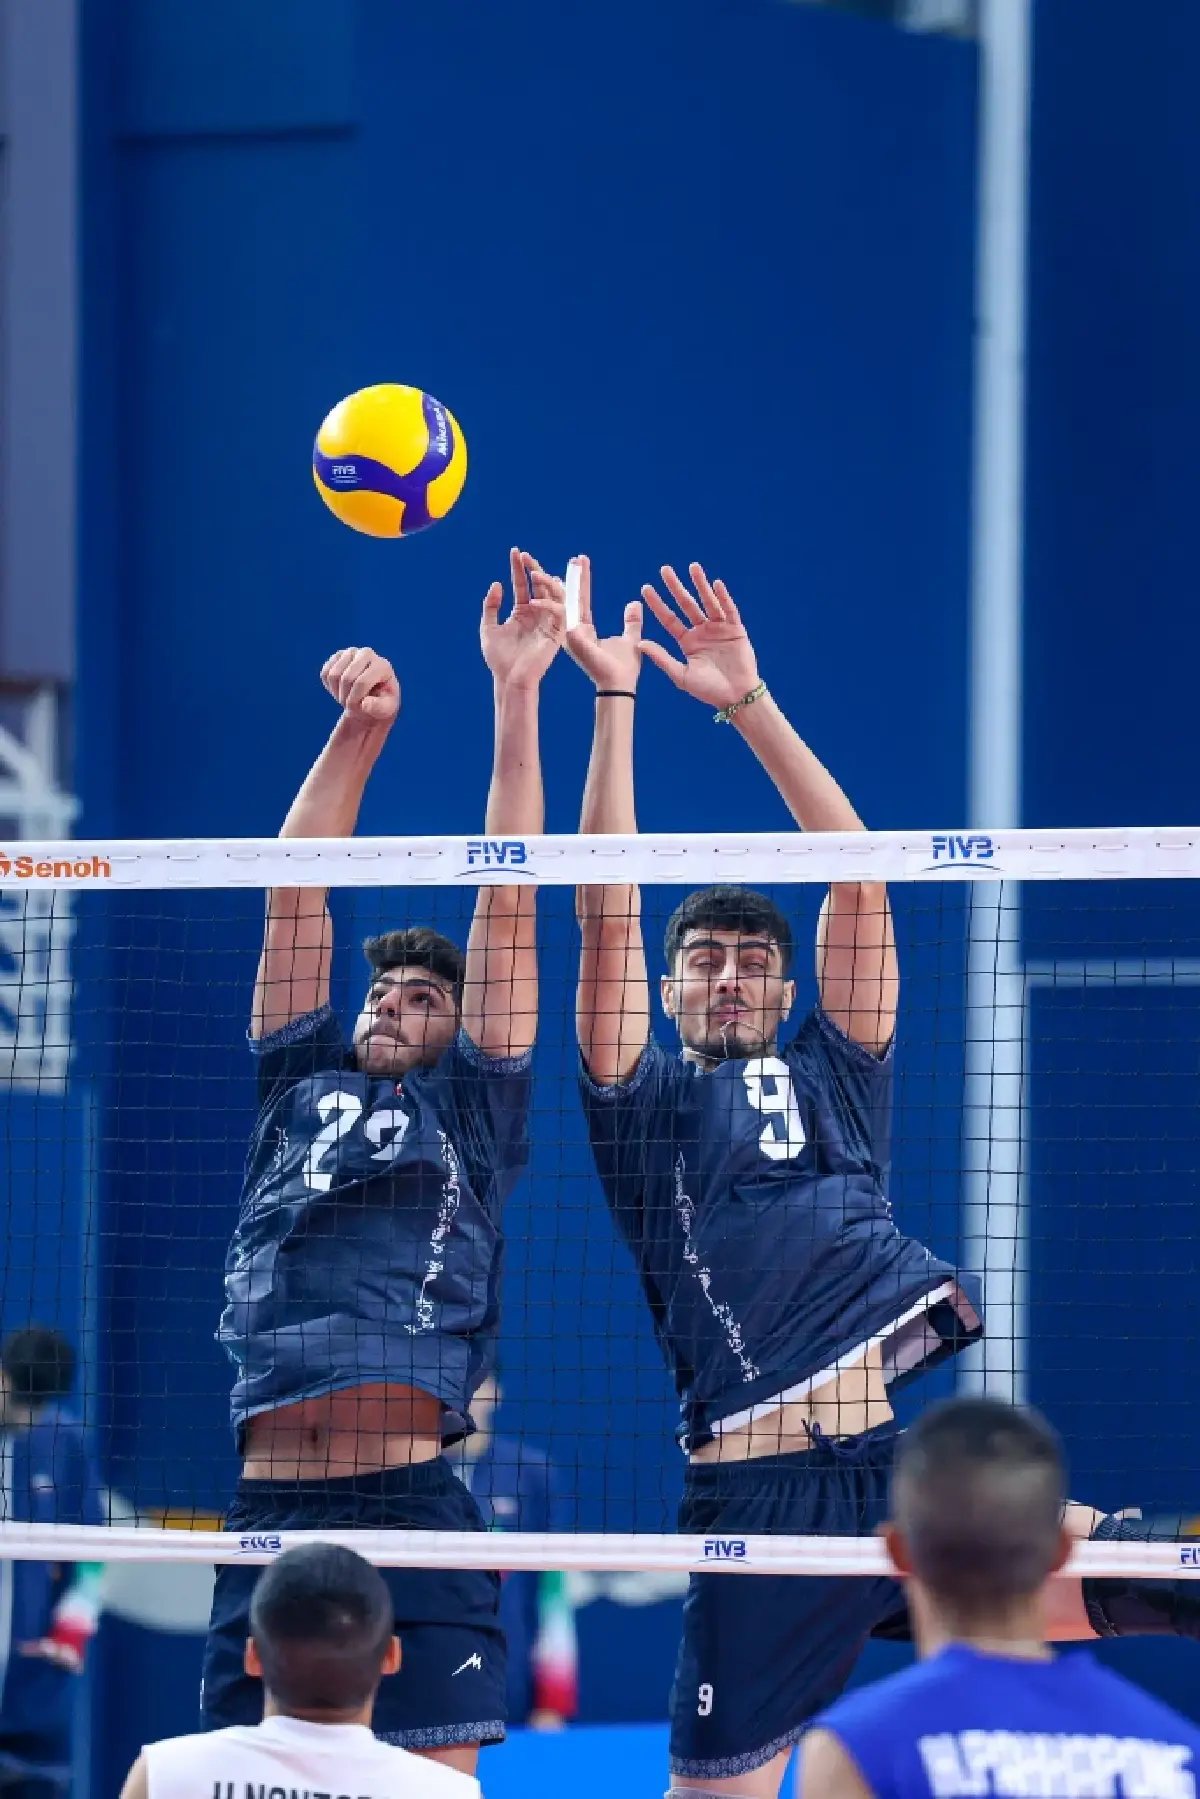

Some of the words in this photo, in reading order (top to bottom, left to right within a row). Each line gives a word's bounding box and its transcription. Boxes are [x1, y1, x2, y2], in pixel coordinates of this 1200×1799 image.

[466, 841, 527, 865] FIVB
[931, 835, 994, 860] FIVB
[15, 855, 111, 878] Senoh
[743, 1056, 806, 1161] 9
[240, 1536, 281, 1549] FIVB
[704, 1540, 747, 1558] FIVB
[698, 1682, 714, 1716] 9
